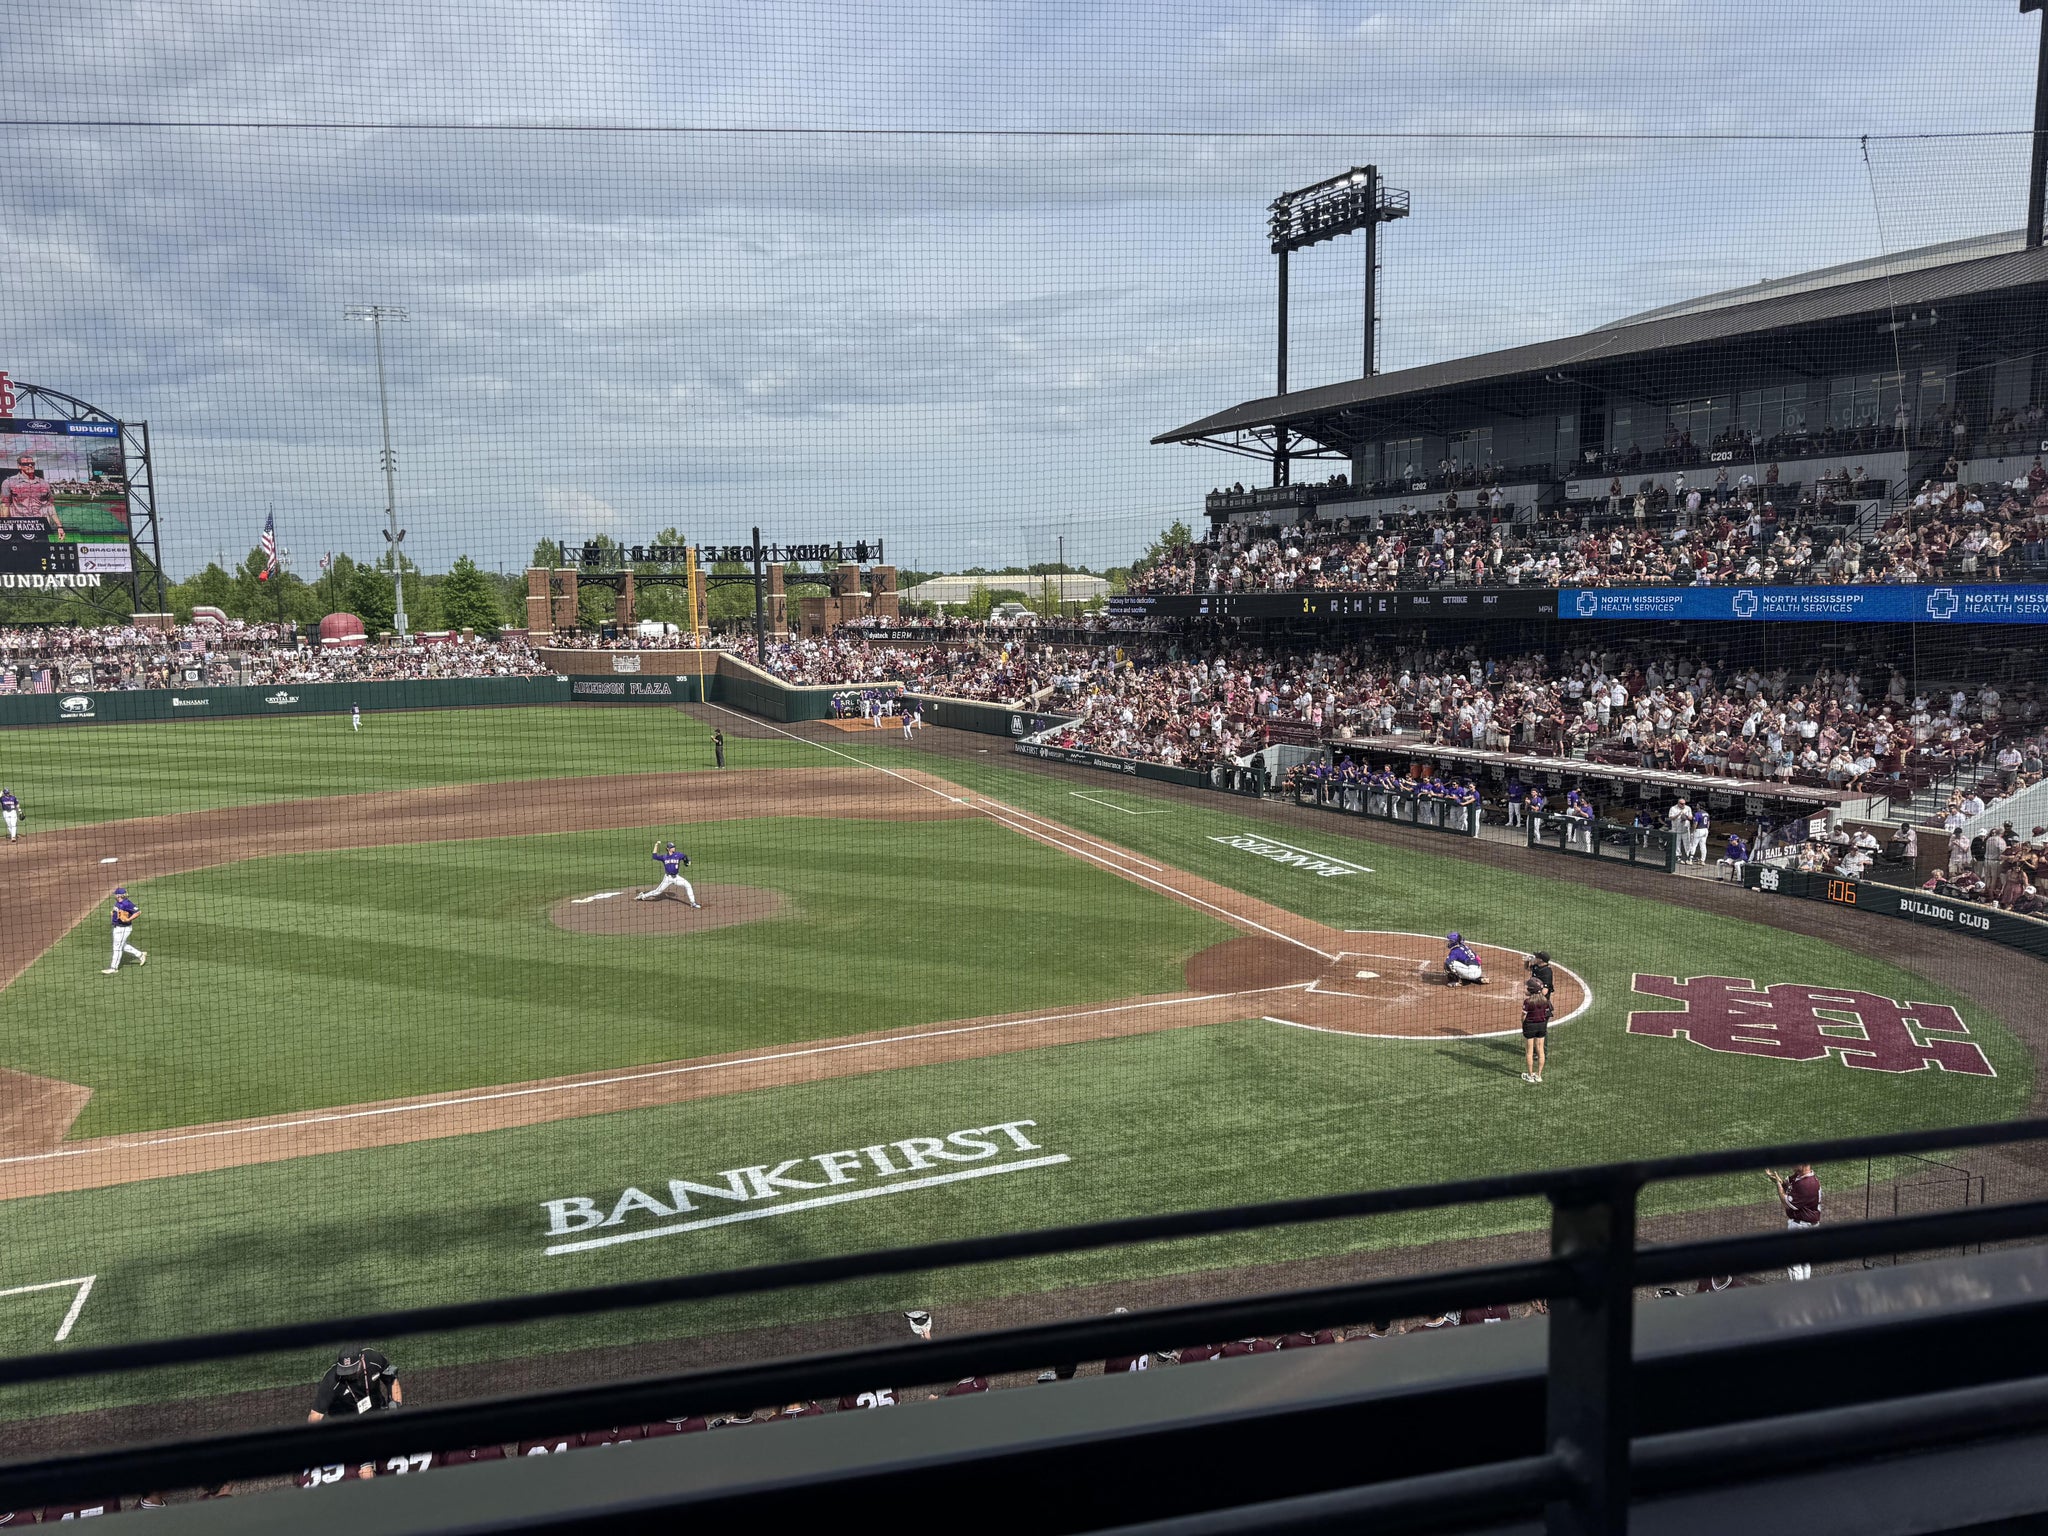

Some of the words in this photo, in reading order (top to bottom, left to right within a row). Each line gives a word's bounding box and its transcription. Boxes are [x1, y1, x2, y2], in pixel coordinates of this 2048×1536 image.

[1711, 451, 1733, 461] C203
[1412, 483, 1427, 491] C202
[0, 573, 101, 588] UNDATION
[1413, 596, 1431, 604] BALL
[1443, 595, 1468, 604] STRIKE
[1483, 595, 1498, 604] OUT
[1763, 595, 1798, 603] NORTH
[1801, 595, 1864, 603] MISSISSIPPI
[1965, 594, 2009, 603] NORTH
[1303, 598, 1309, 613] 3
[1331, 600, 1339, 612] R
[1353, 600, 1362, 612] H
[1379, 599, 1387, 612] E
[1538, 605, 1553, 613] MPH
[1634, 604, 1674, 612] SERVICES
[1762, 604, 1800, 612] HEALTH
[1803, 604, 1853, 612] SERVICES
[1964, 604, 2012, 613] HEALTH
[2016, 604, 2048, 613] SERV
[892, 631, 912, 639] BERM
[573, 682, 625, 694] ADKERSON
[630, 682, 672, 695] PLAZA
[1765, 847, 1783, 859] HAIL
[1827, 879, 1857, 904] 1:06
[1900, 898, 1954, 922] BULLDOG
[1959, 911, 1990, 931] CLUB
[540, 1119, 1042, 1236] BANKFIRST
